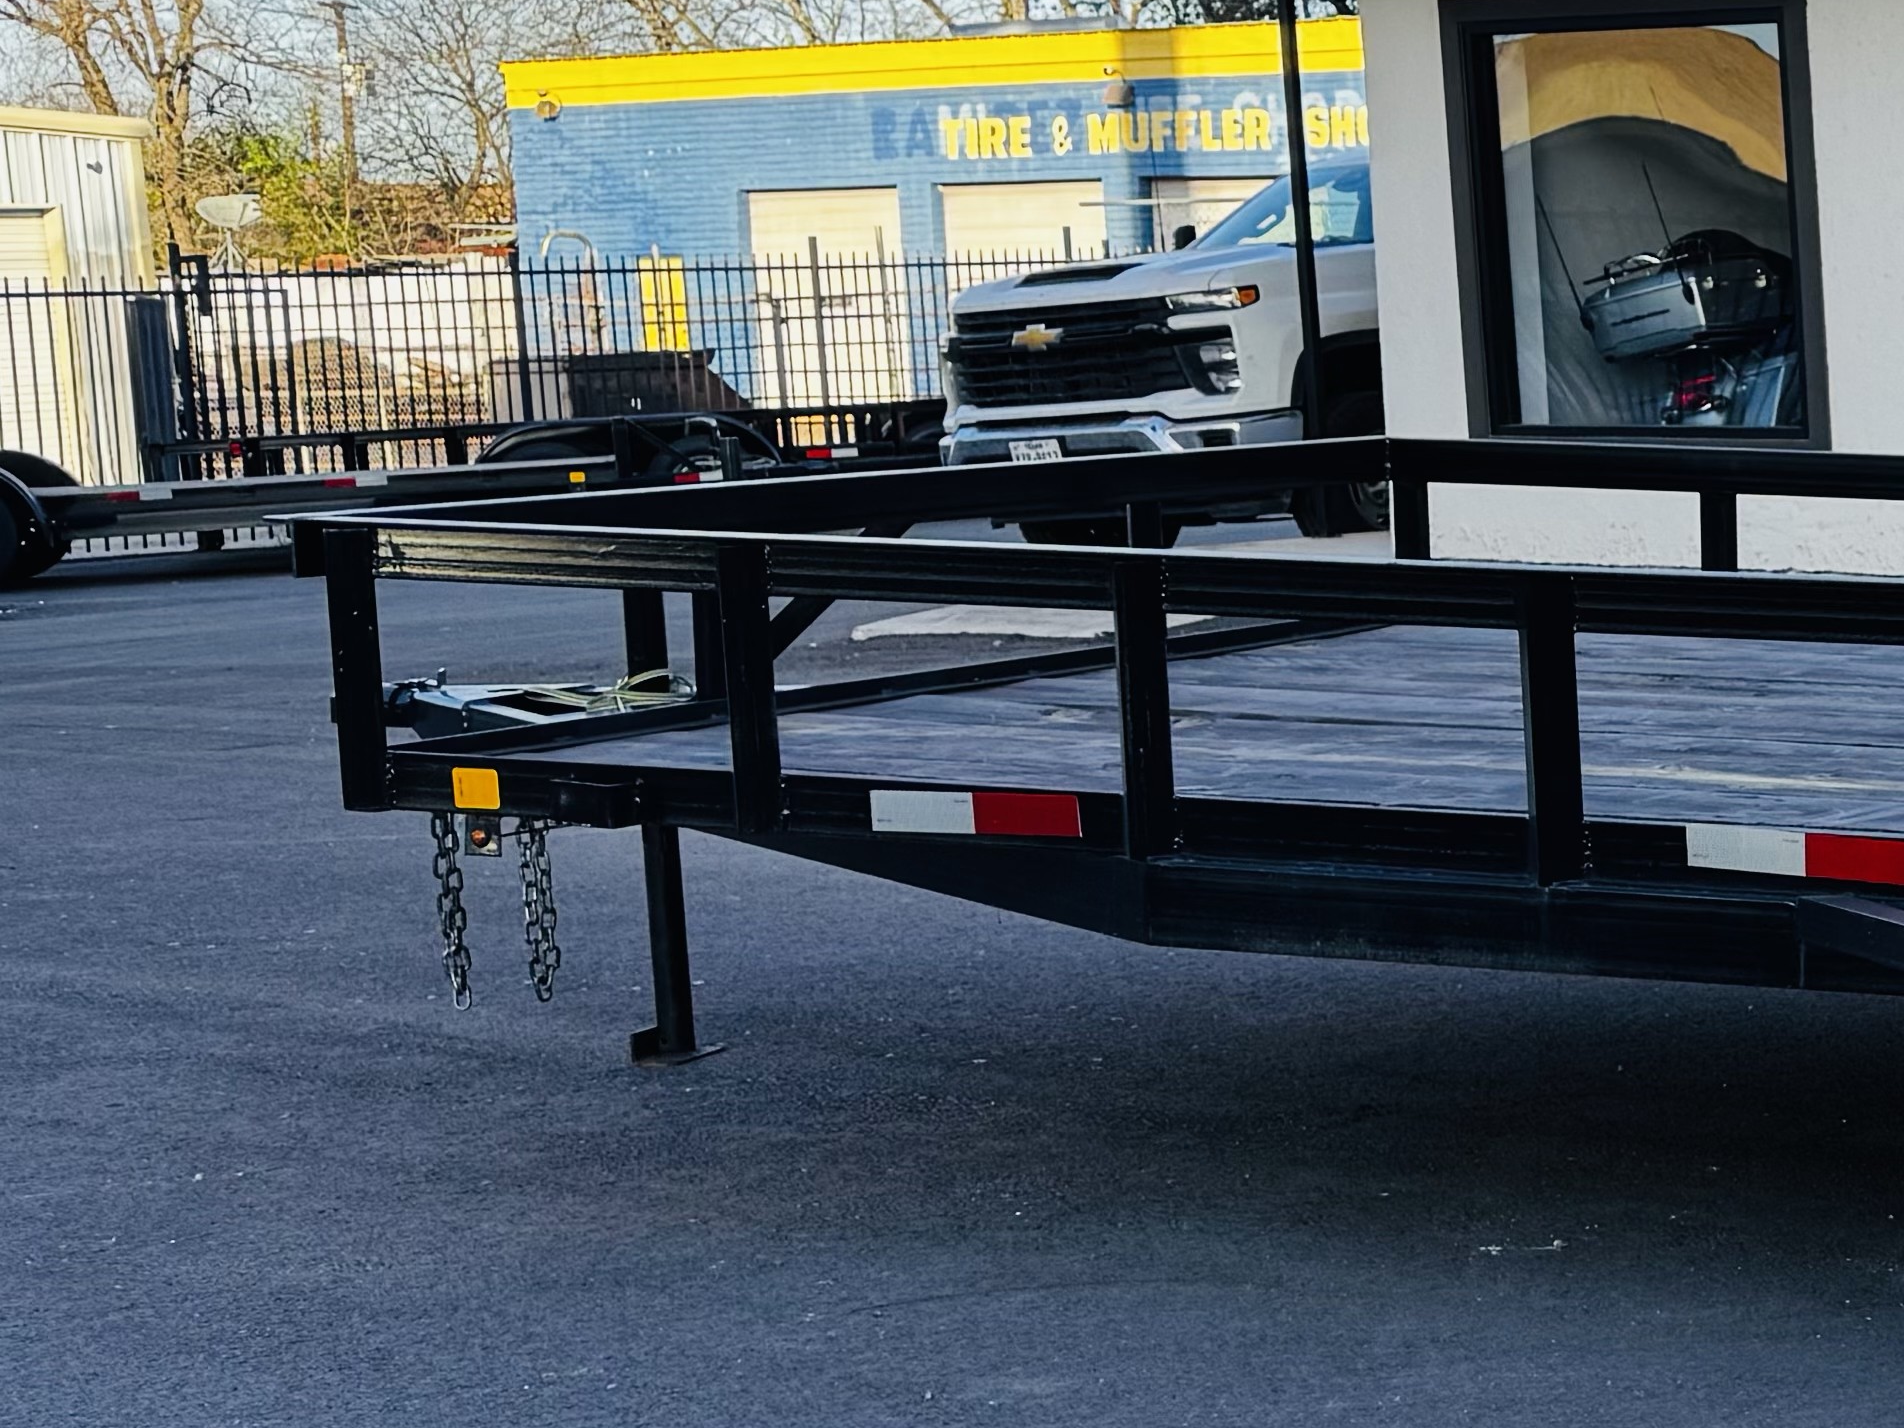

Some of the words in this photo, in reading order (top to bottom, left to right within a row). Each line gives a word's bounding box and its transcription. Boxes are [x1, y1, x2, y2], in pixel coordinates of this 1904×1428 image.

[941, 116, 1032, 160] TIRE
[1051, 115, 1072, 156] &
[1086, 108, 1272, 154] MUFFLER
